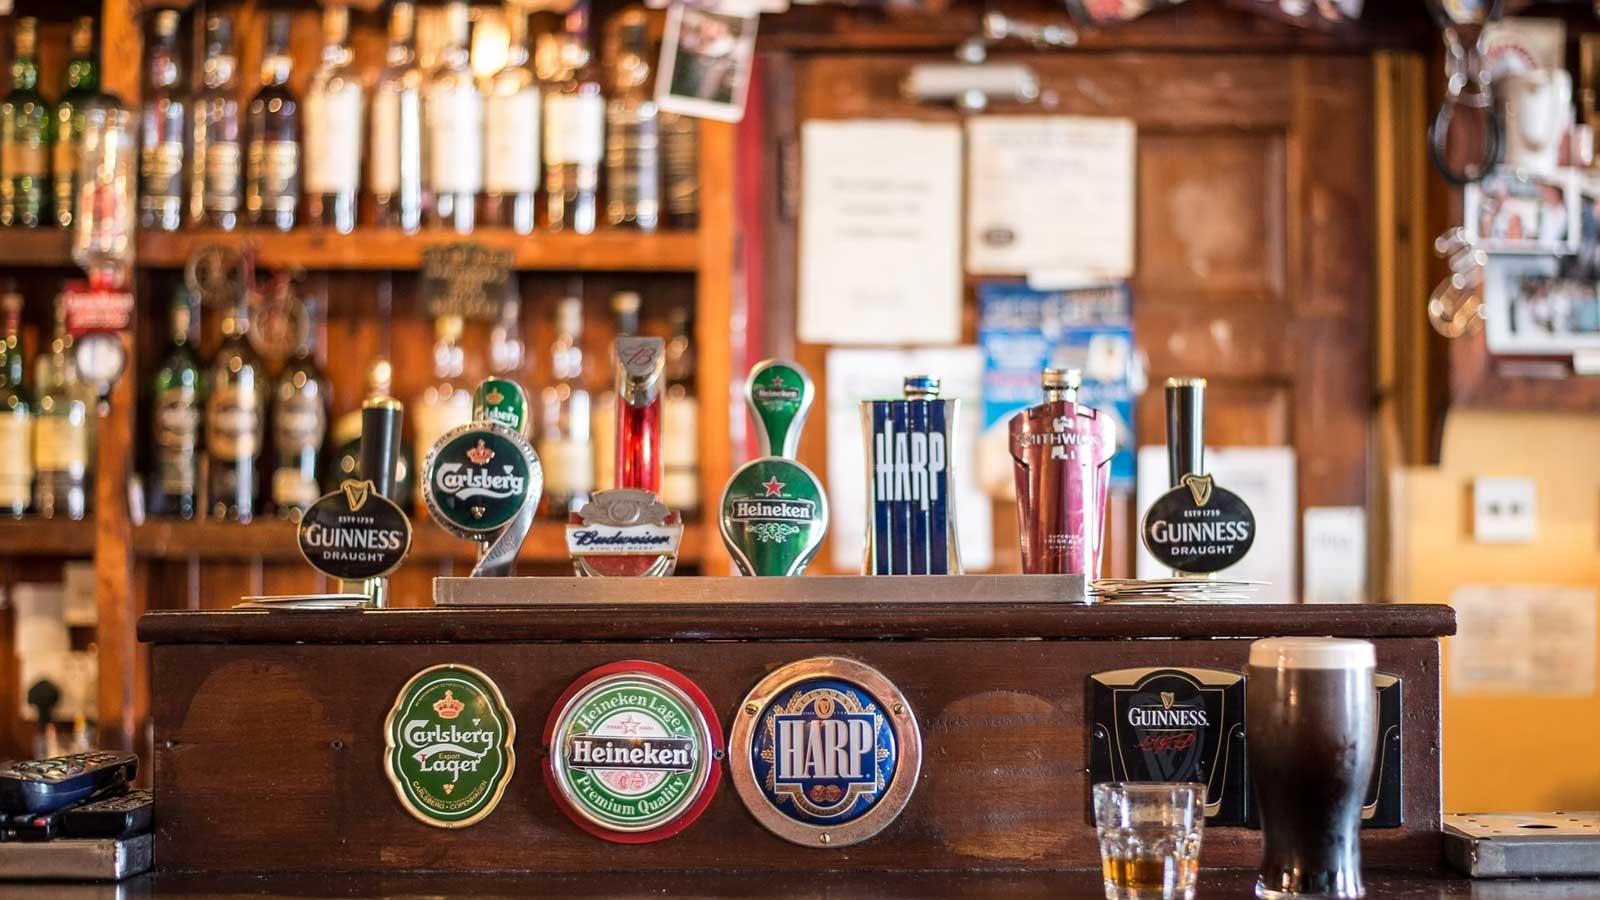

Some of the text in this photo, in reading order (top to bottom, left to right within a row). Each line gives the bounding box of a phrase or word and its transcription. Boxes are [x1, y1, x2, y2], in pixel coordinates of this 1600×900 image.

[876, 419, 945, 511] HARP
[436, 463, 525, 496] Carlsberg
[737, 502, 810, 518] Heineken
[1203, 509, 1221, 517] 1759
[306, 523, 401, 550] GUINNESS
[573, 530, 670, 546] Budweiser
[1151, 520, 1249, 543] GUINNESS
[323, 551, 385, 562] DRAUGHT
[1171, 545, 1234, 556] DRAUGHT
[577, 692, 686, 734] Heineken Lager
[1128, 706, 1208, 727] GUINNESS
[404, 719, 494, 751] Carlsberg
[778, 719, 874, 778] HARP
[573, 740, 690, 765] Heineken
[419, 753, 482, 783] Lager
[412, 780, 445, 810] CARLSBERG
[449, 780, 488, 810] COPENHAGEN
[577, 774, 685, 815] Premium Quality
